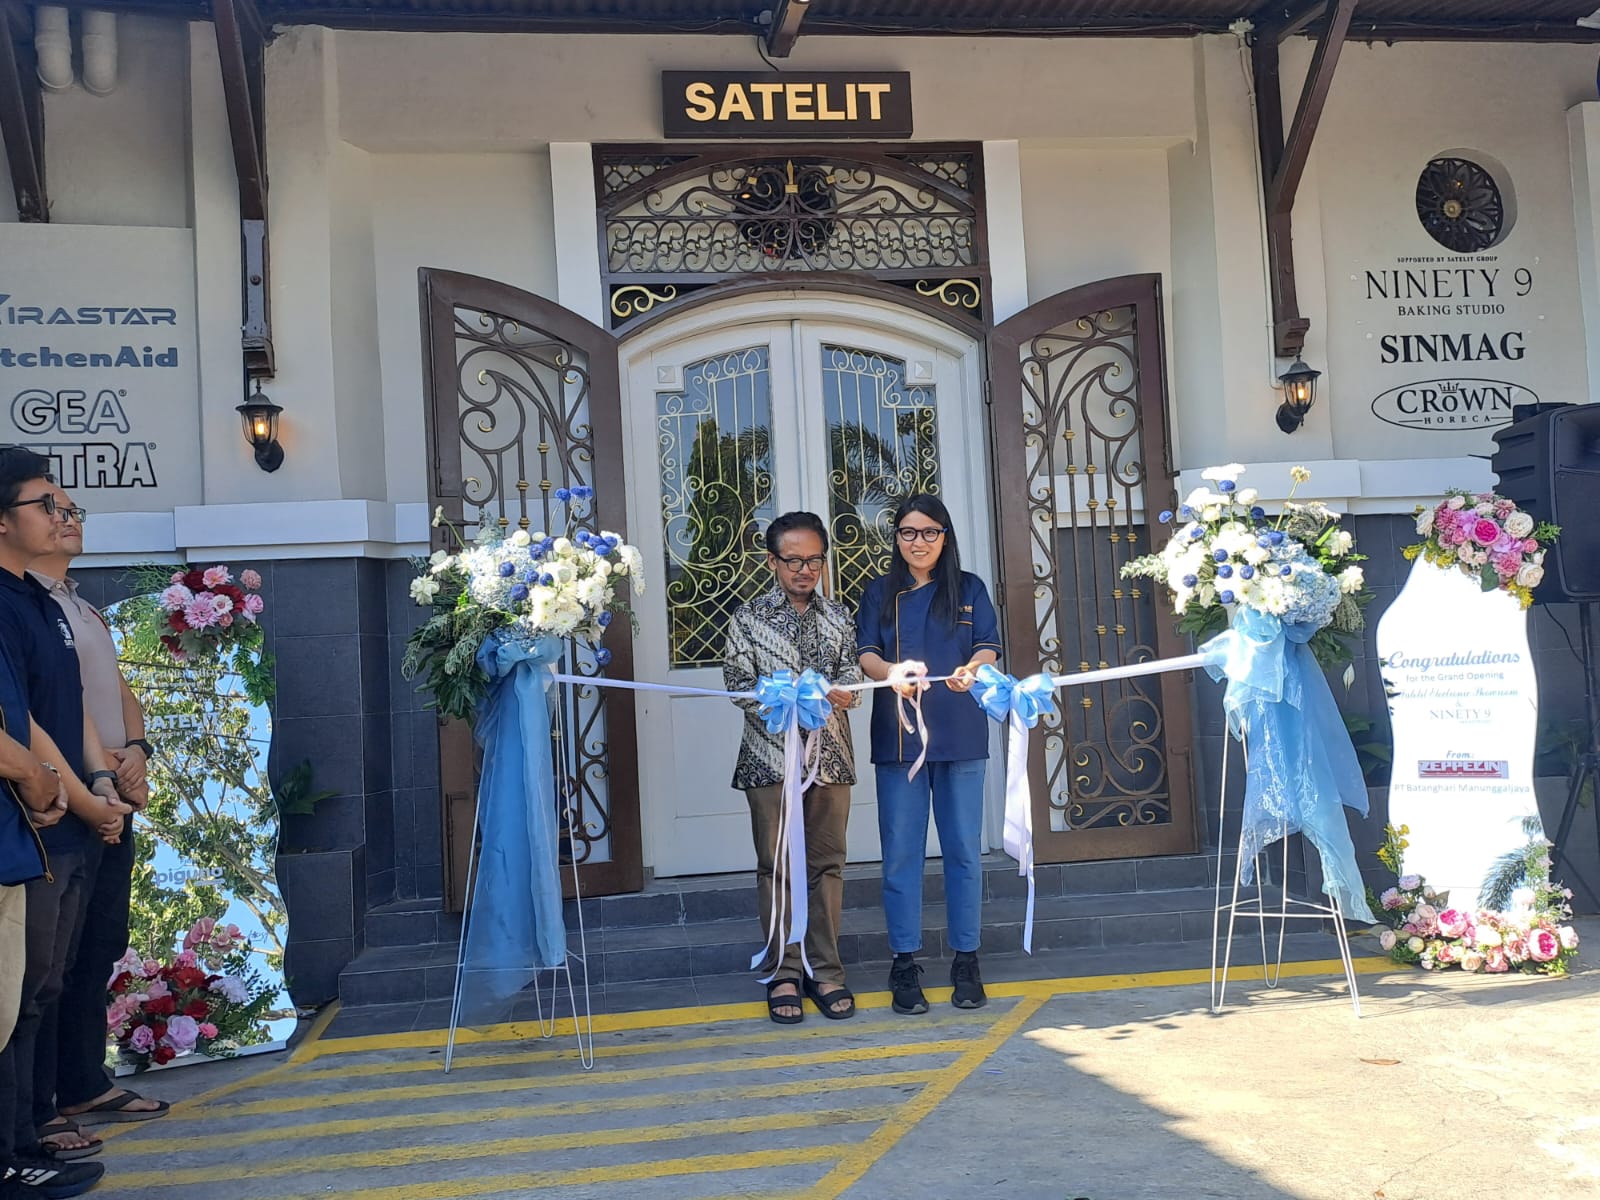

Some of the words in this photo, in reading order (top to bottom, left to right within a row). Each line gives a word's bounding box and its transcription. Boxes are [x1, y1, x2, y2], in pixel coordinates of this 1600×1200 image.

[685, 82, 891, 121] SATELIT
[1365, 268, 1500, 299] NINETY
[1514, 268, 1533, 296] 9
[0, 294, 177, 325] IRASTAR
[1398, 305, 1451, 316] BAKING
[1456, 304, 1505, 315] STUDIO
[0, 346, 178, 367] tchenAid
[1380, 331, 1527, 364] SINMAG
[1424, 416, 1491, 425] HORECA
[0, 442, 157, 488] TRA
[1388, 650, 1520, 672] Congratulations
[1406, 674, 1418, 682] for
[1438, 672, 1464, 681] Grand
[1467, 671, 1504, 681] Opening
[1430, 709, 1480, 719] NINETY
